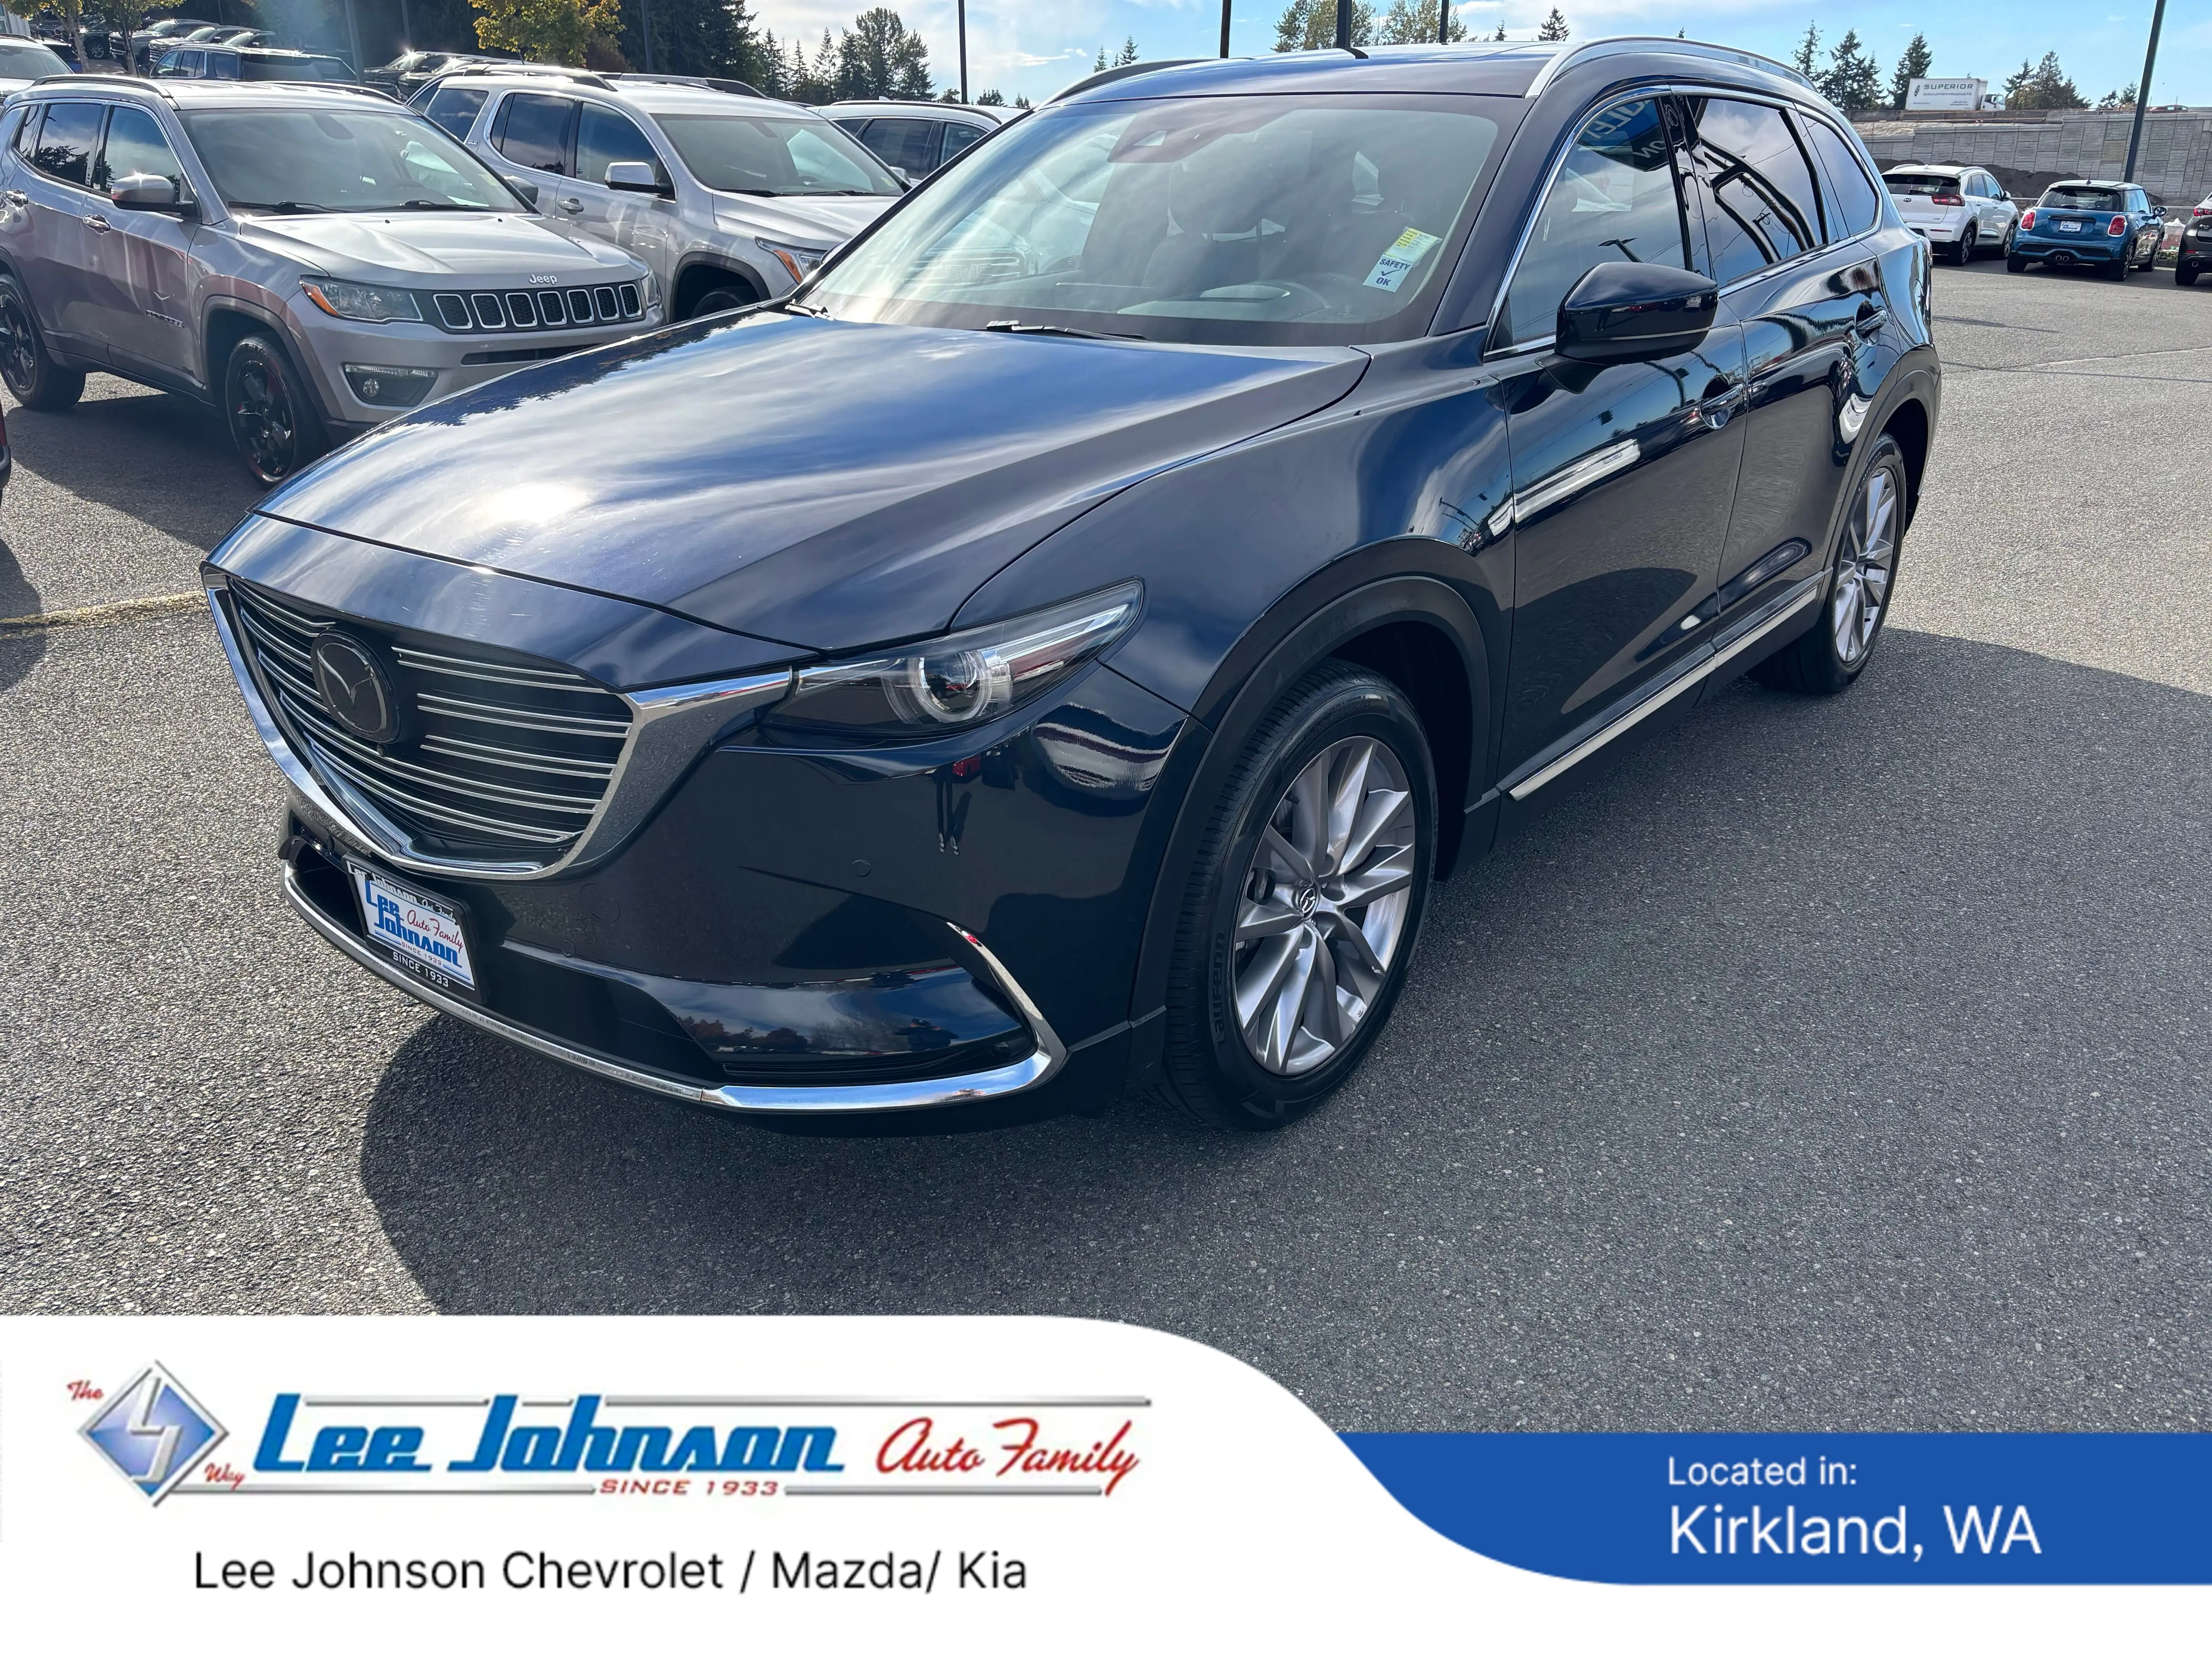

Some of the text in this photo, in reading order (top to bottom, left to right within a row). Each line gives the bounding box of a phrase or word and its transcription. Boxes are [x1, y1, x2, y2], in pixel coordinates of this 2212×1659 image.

[946, 264, 992, 279] GMC
[1379, 258, 1411, 270] SAFETY
[529, 274, 558, 285] Jeep
[1376, 277, 1392, 286] OK
[364, 879, 400, 914] Lee
[371, 872, 421, 905] Johnson
[374, 907, 462, 969] Johnson
[407, 910, 464, 954] Auto Family
[401, 941, 441, 965] SINCE 1933
[393, 951, 449, 988] SINCE 1933
